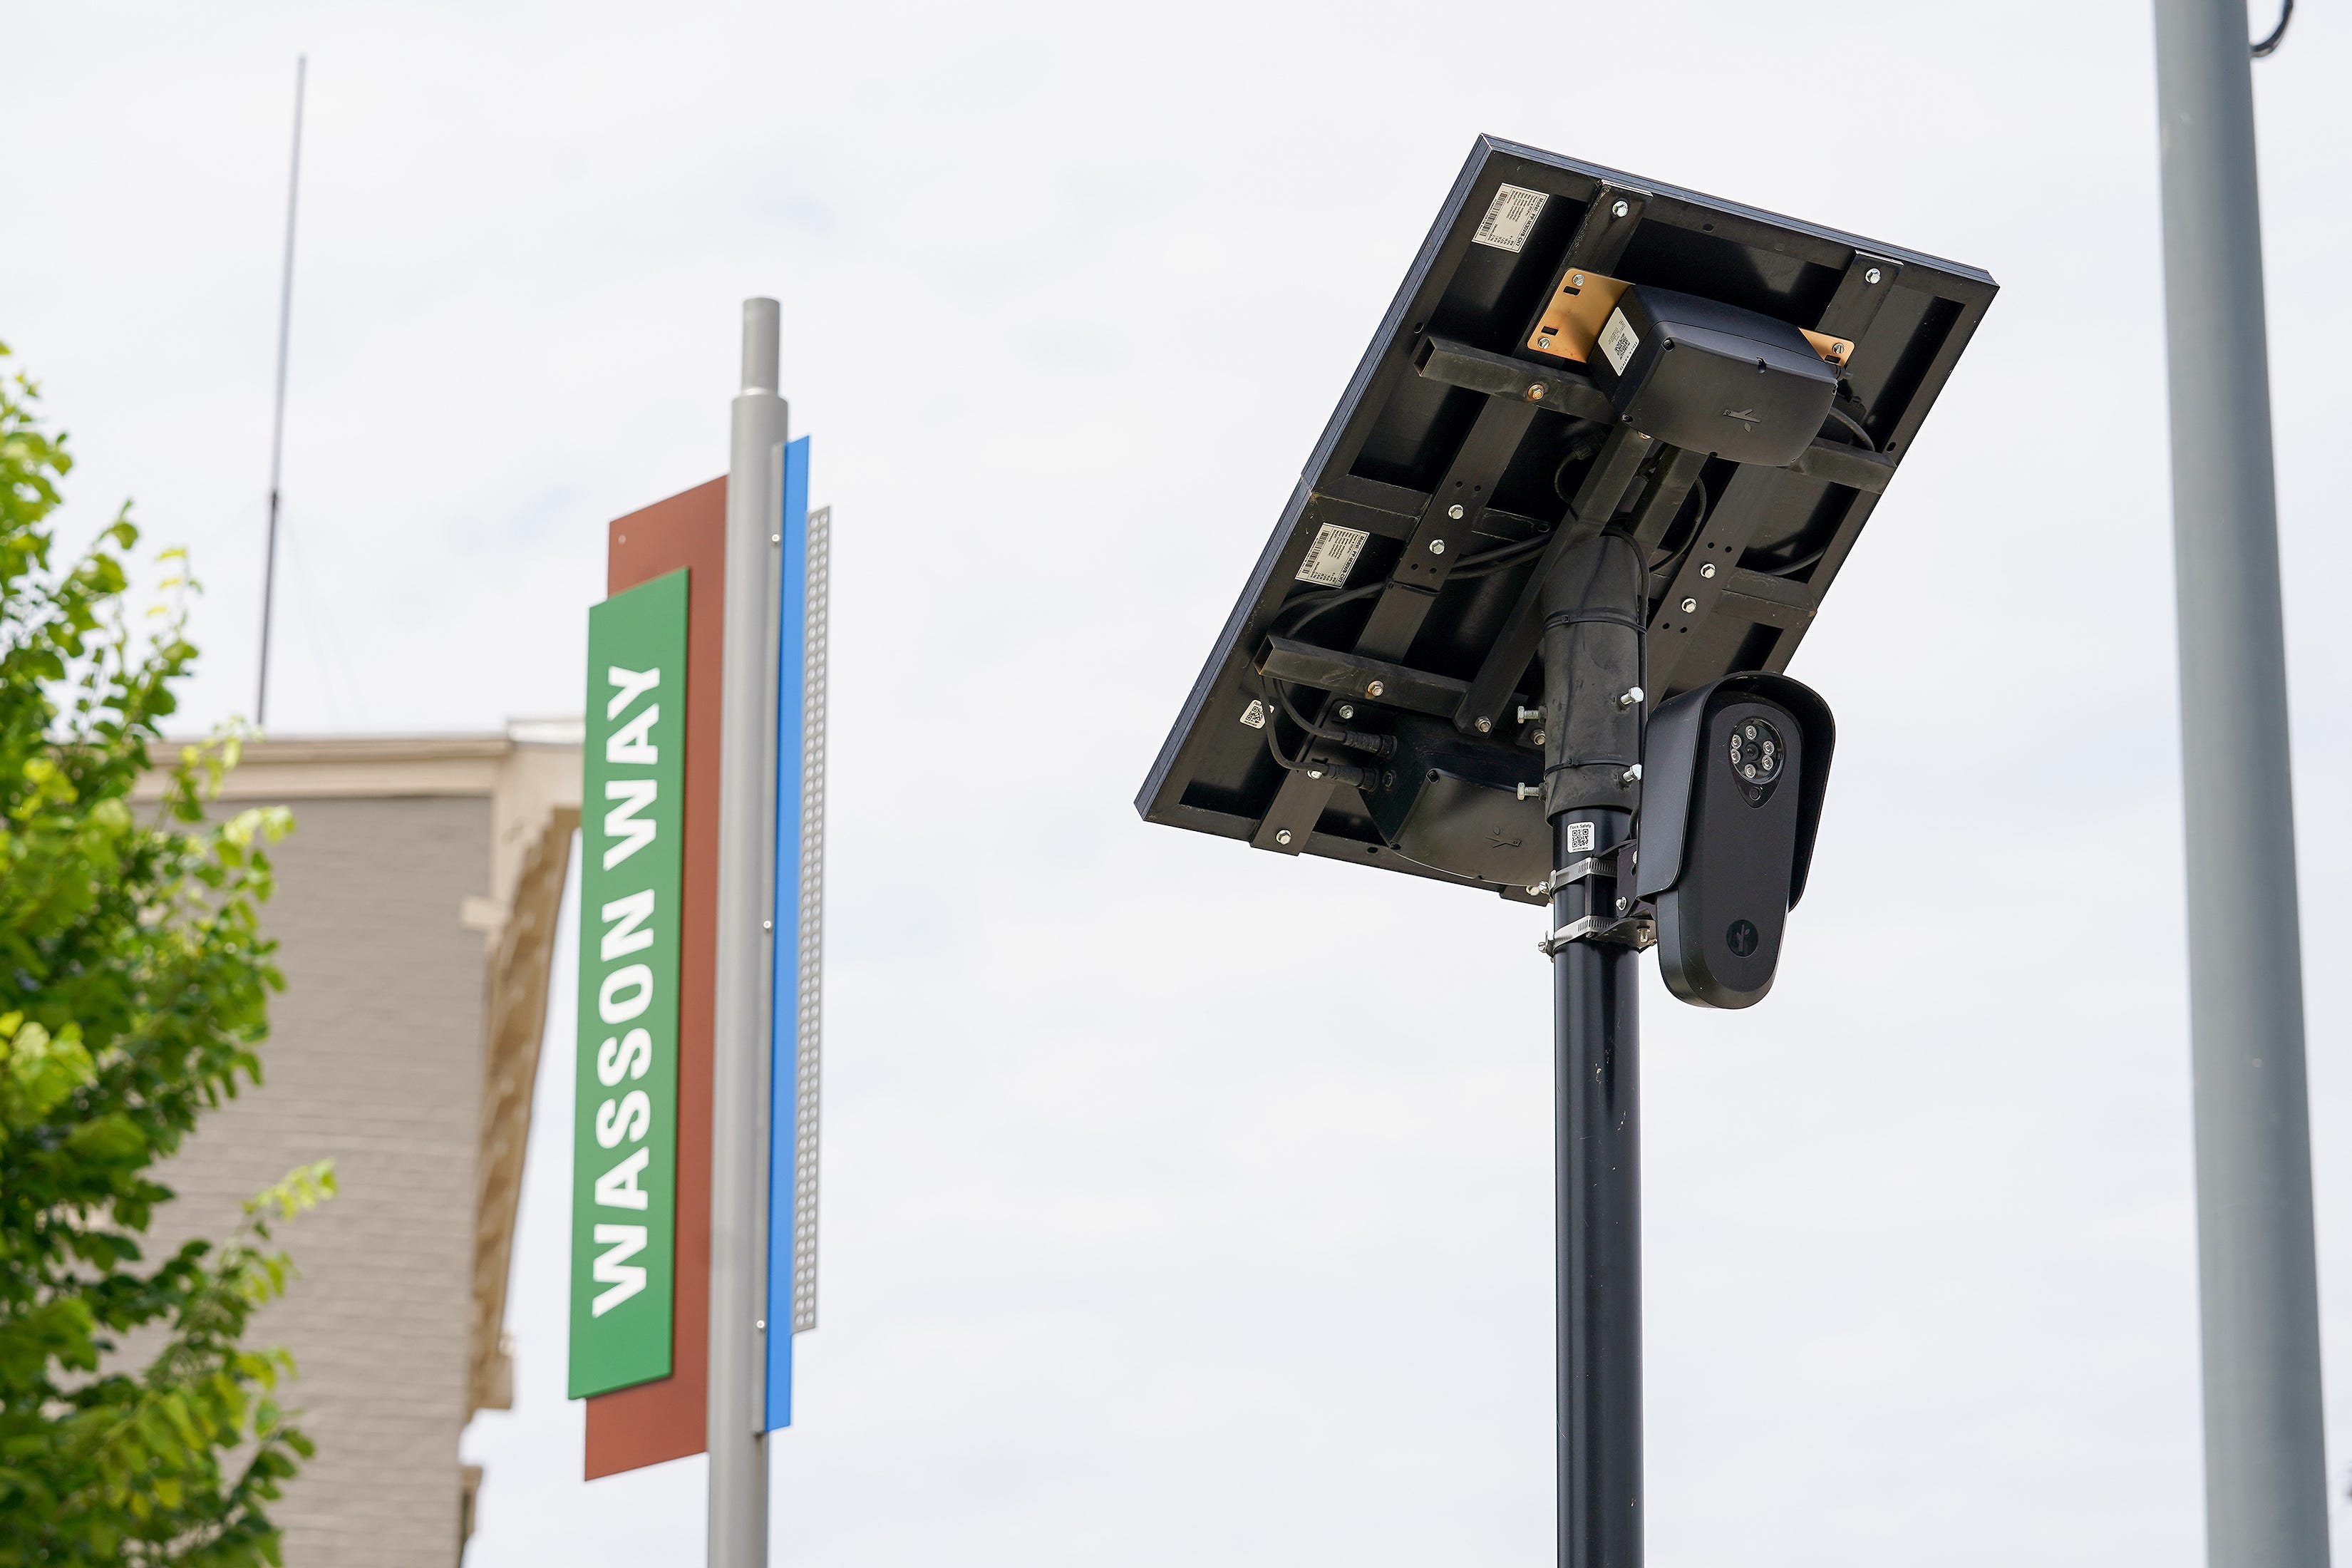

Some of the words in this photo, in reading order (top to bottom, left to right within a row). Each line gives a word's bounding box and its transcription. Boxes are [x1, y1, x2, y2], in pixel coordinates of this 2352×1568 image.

[1532, 197, 1544, 212] Model:
[1353, 535, 1365, 550] Model:
[603, 666, 660, 871] WAY
[592, 889, 655, 1317] WASSON
